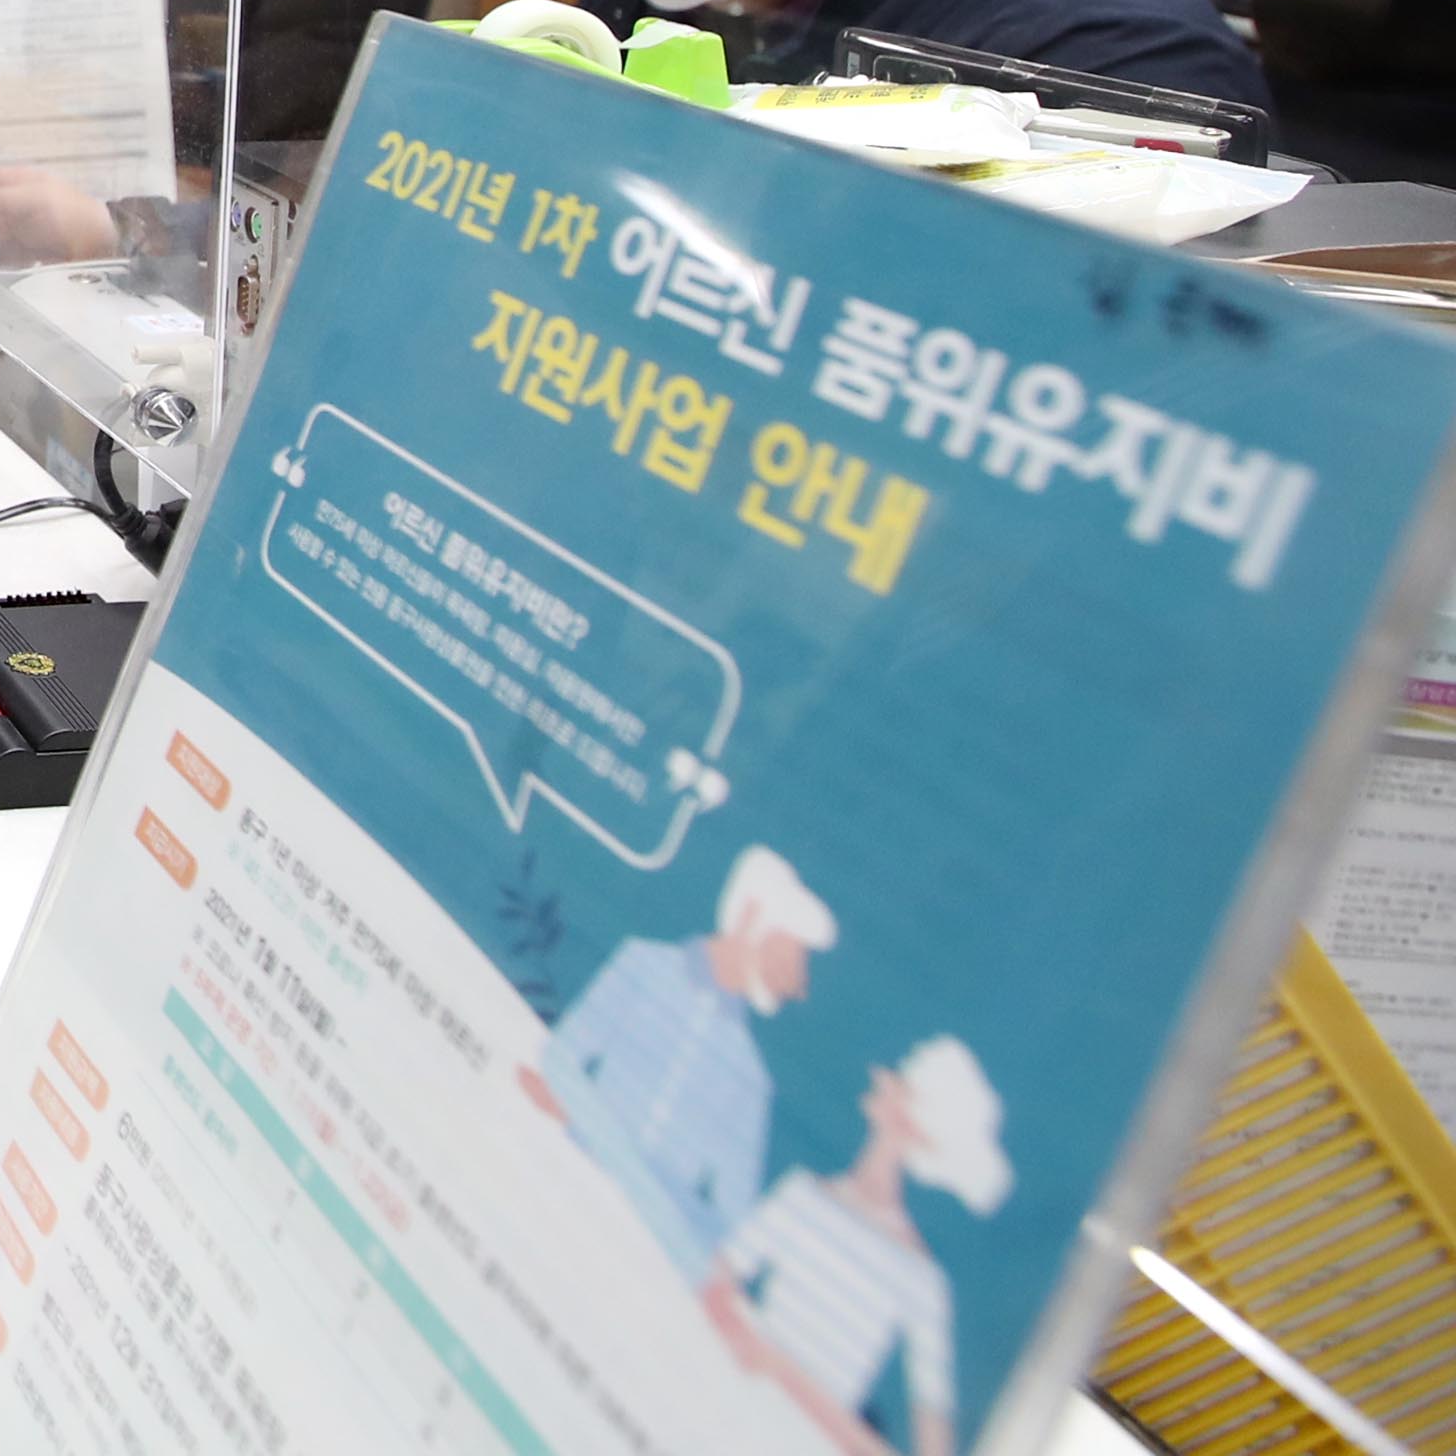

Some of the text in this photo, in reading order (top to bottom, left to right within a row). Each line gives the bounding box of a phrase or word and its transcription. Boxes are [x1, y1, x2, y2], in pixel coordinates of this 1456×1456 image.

[365, 130, 516, 243] 2021년
[520, 188, 600, 280] 1차
[609, 216, 812, 377] 어르신
[811, 296, 1317, 592] 품위유지비
[472, 289, 933, 597] 지원사업 안내
[384, 490, 445, 555] 어르신
